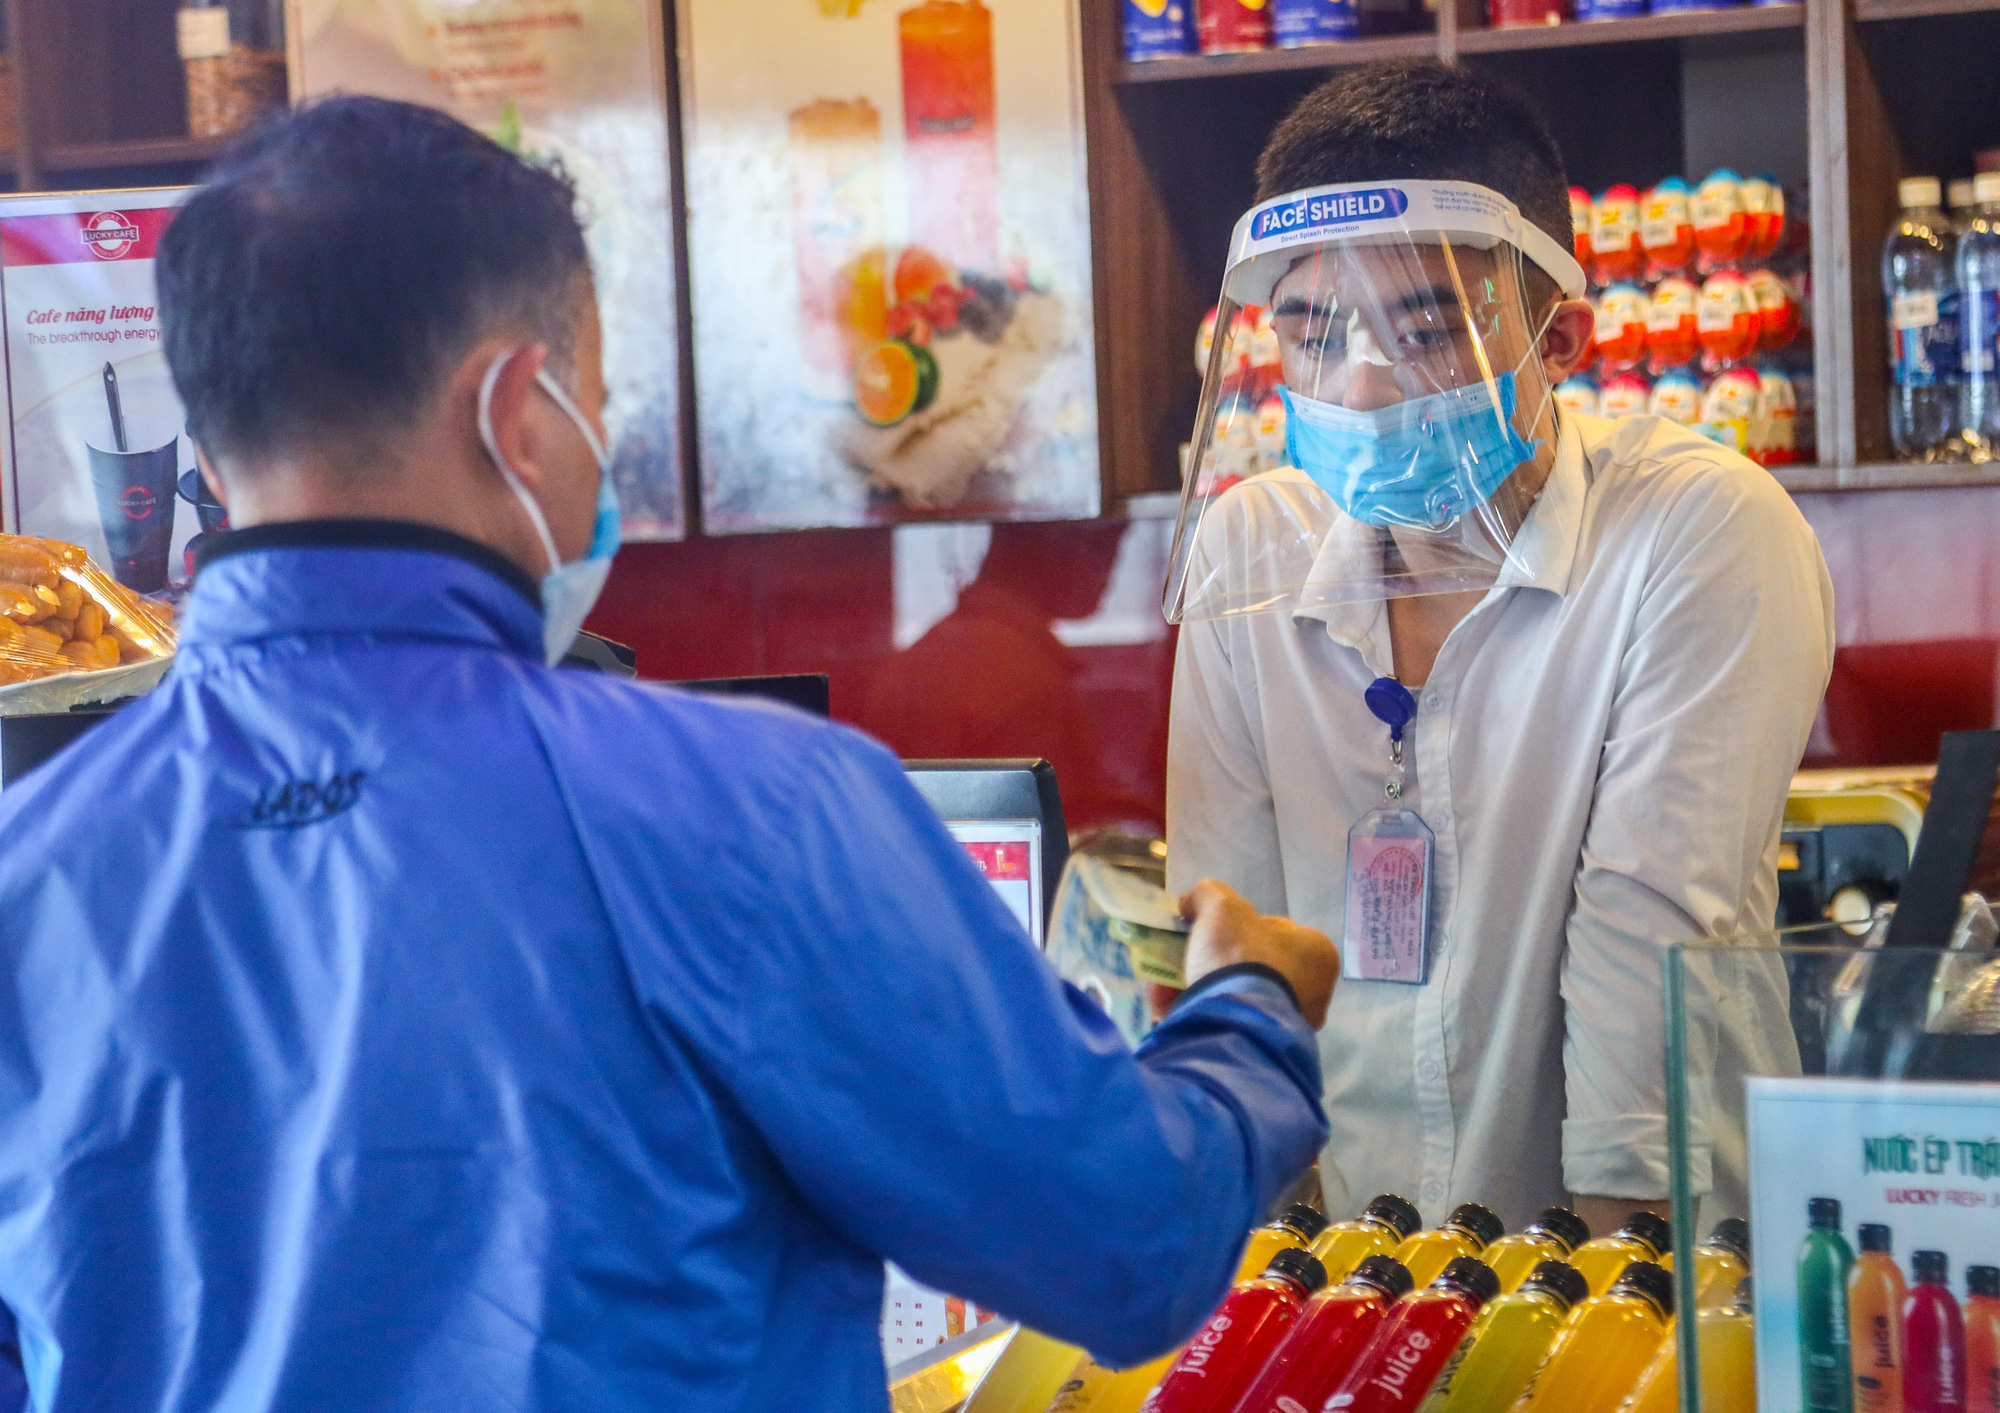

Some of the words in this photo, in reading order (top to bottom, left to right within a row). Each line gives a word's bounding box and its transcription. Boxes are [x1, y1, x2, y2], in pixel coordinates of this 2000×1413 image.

[1262, 206, 1305, 233] FACE
[1310, 195, 1385, 221] SHIELD
[85, 231, 112, 241] LUCKY
[113, 229, 135, 239] CAFE
[1280, 234, 1298, 243] Direct
[1299, 230, 1322, 240] Splash
[1323, 225, 1360, 236] Protection
[27, 309, 62, 325] Cafe
[65, 306, 106, 325] năng
[109, 305, 154, 323] lượng
[28, 332, 46, 345] The
[49, 329, 121, 344] breakthrough
[124, 328, 160, 341] energy
[1885, 1188, 1941, 1205] LUCKY
[1176, 1315, 1233, 1378] juice
[1873, 1314, 1895, 1369] juice
[1370, 1330, 1432, 1400] juice
